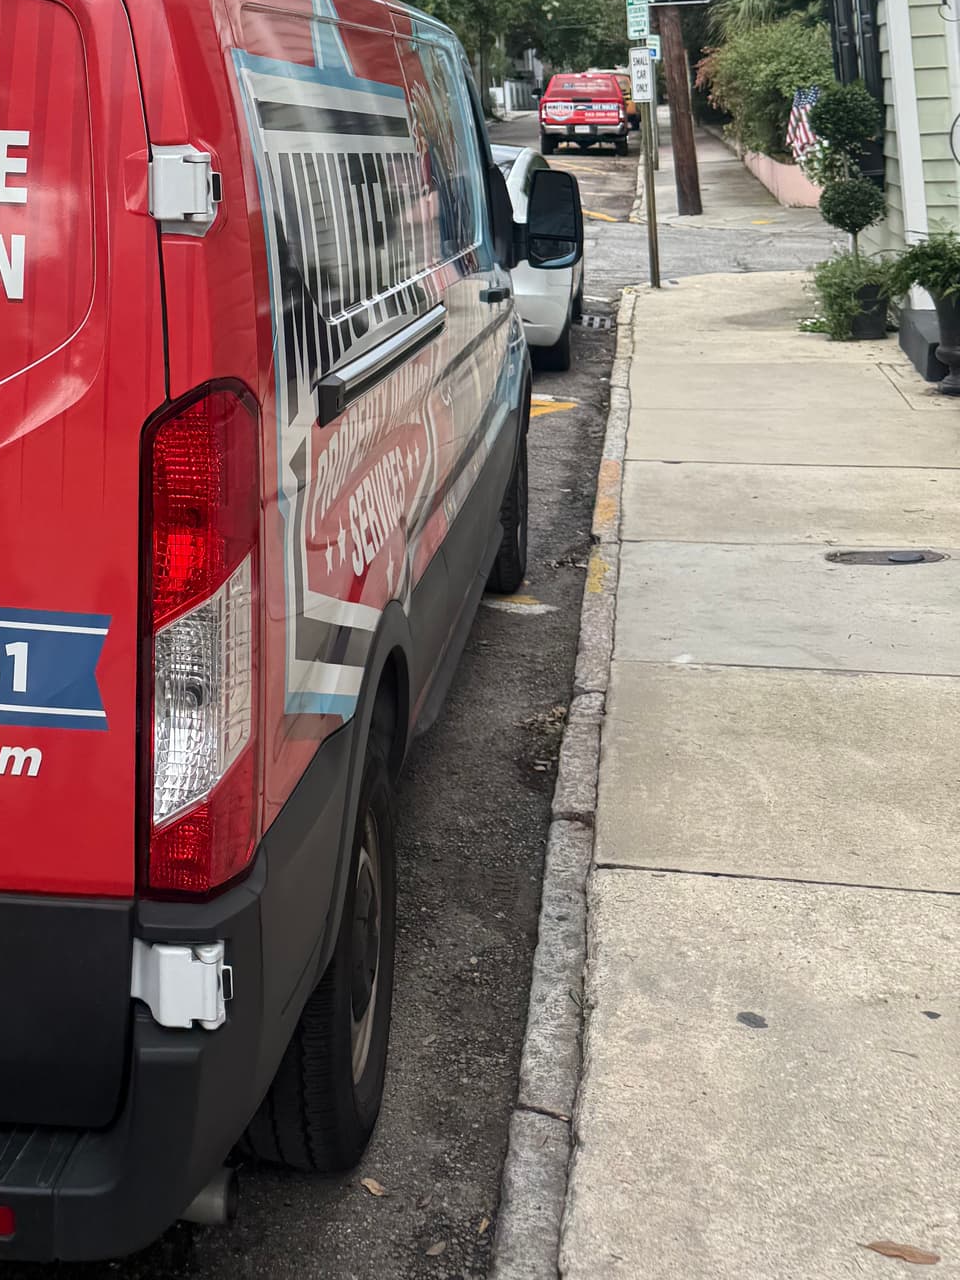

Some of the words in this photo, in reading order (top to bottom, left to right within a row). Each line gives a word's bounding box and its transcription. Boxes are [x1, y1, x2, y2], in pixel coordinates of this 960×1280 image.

[632, 57, 649, 66] SMALL
[636, 70, 647, 79] CAR
[635, 84, 648, 93] ONLY
[311, 385, 388, 539] PROPERTY
[348, 446, 407, 577] SERVICES
